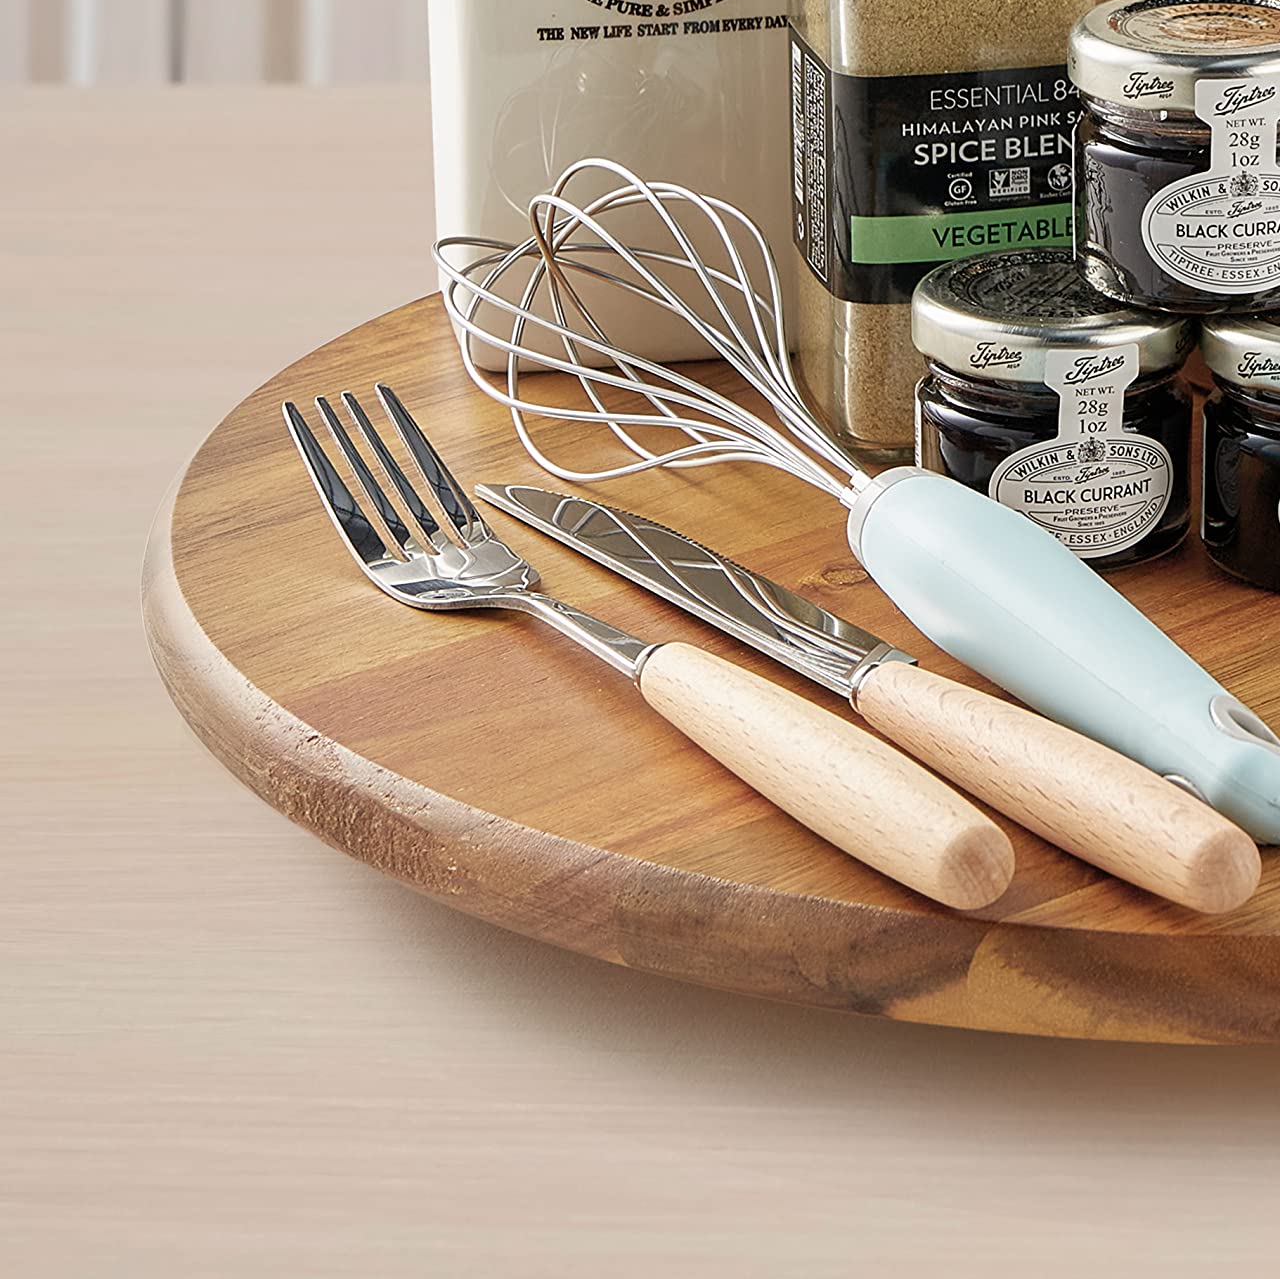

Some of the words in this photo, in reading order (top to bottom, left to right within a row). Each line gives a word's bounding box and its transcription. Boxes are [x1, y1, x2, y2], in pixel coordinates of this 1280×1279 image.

[655, 3, 671, 17] &
[536, 27, 565, 42] THE
[569, 26, 600, 41] NEW
[602, 25, 633, 39] LIFE
[636, 21, 679, 38] START
[682, 20, 721, 35] FROM
[721, 17, 763, 33] EVERY
[764, 15, 789, 30] DAY
[930, 82, 1050, 111] ESSENTIAL
[1123, 71, 1175, 100] Tiptree
[1213, 84, 1276, 116] Tiptree
[901, 117, 1014, 138] HIMALAYAN
[1019, 112, 1061, 131] PINK
[1226, 120, 1245, 129] NET
[1248, 118, 1267, 128] WT.
[913, 139, 996, 167] SPICE
[1004, 133, 1073, 161] BLEN
[1229, 132, 1260, 150] 28g
[1231, 152, 1260, 167] 1oz
[953, 184, 967, 194] GF
[1165, 185, 1212, 213] WILKIN
[1217, 183, 1228, 195] &
[1226, 200, 1263, 219] Tiptree
[1175, 223, 1229, 240] BLACK
[1217, 240, 1273, 251] PRESERVE
[1168, 250, 1215, 278] TIPTREE
[1221, 270, 1261, 280] ESSEX
[969, 341, 1023, 370] Tiptree
[1063, 355, 1125, 385] Tiptree
[1075, 387, 1095, 397] NET
[1097, 386, 1115, 396] WT.
[1078, 400, 1109, 417] 28g
[1079, 418, 1108, 434] 1oz
[1014, 450, 1060, 478] WILKIN
[1066, 449, 1075, 461] &
[1109, 445, 1140, 459] SONS
[1141, 450, 1159, 467] LTD
[1074, 466, 1110, 485] Tiptree
[1024, 489, 1077, 504] BLACK
[1080, 478, 1153, 503] CURRANT
[1064, 504, 1120, 516] PRESERVE
[1069, 533, 1107, 544] ESSEX
[1113, 502, 1159, 539] ENGLAND
